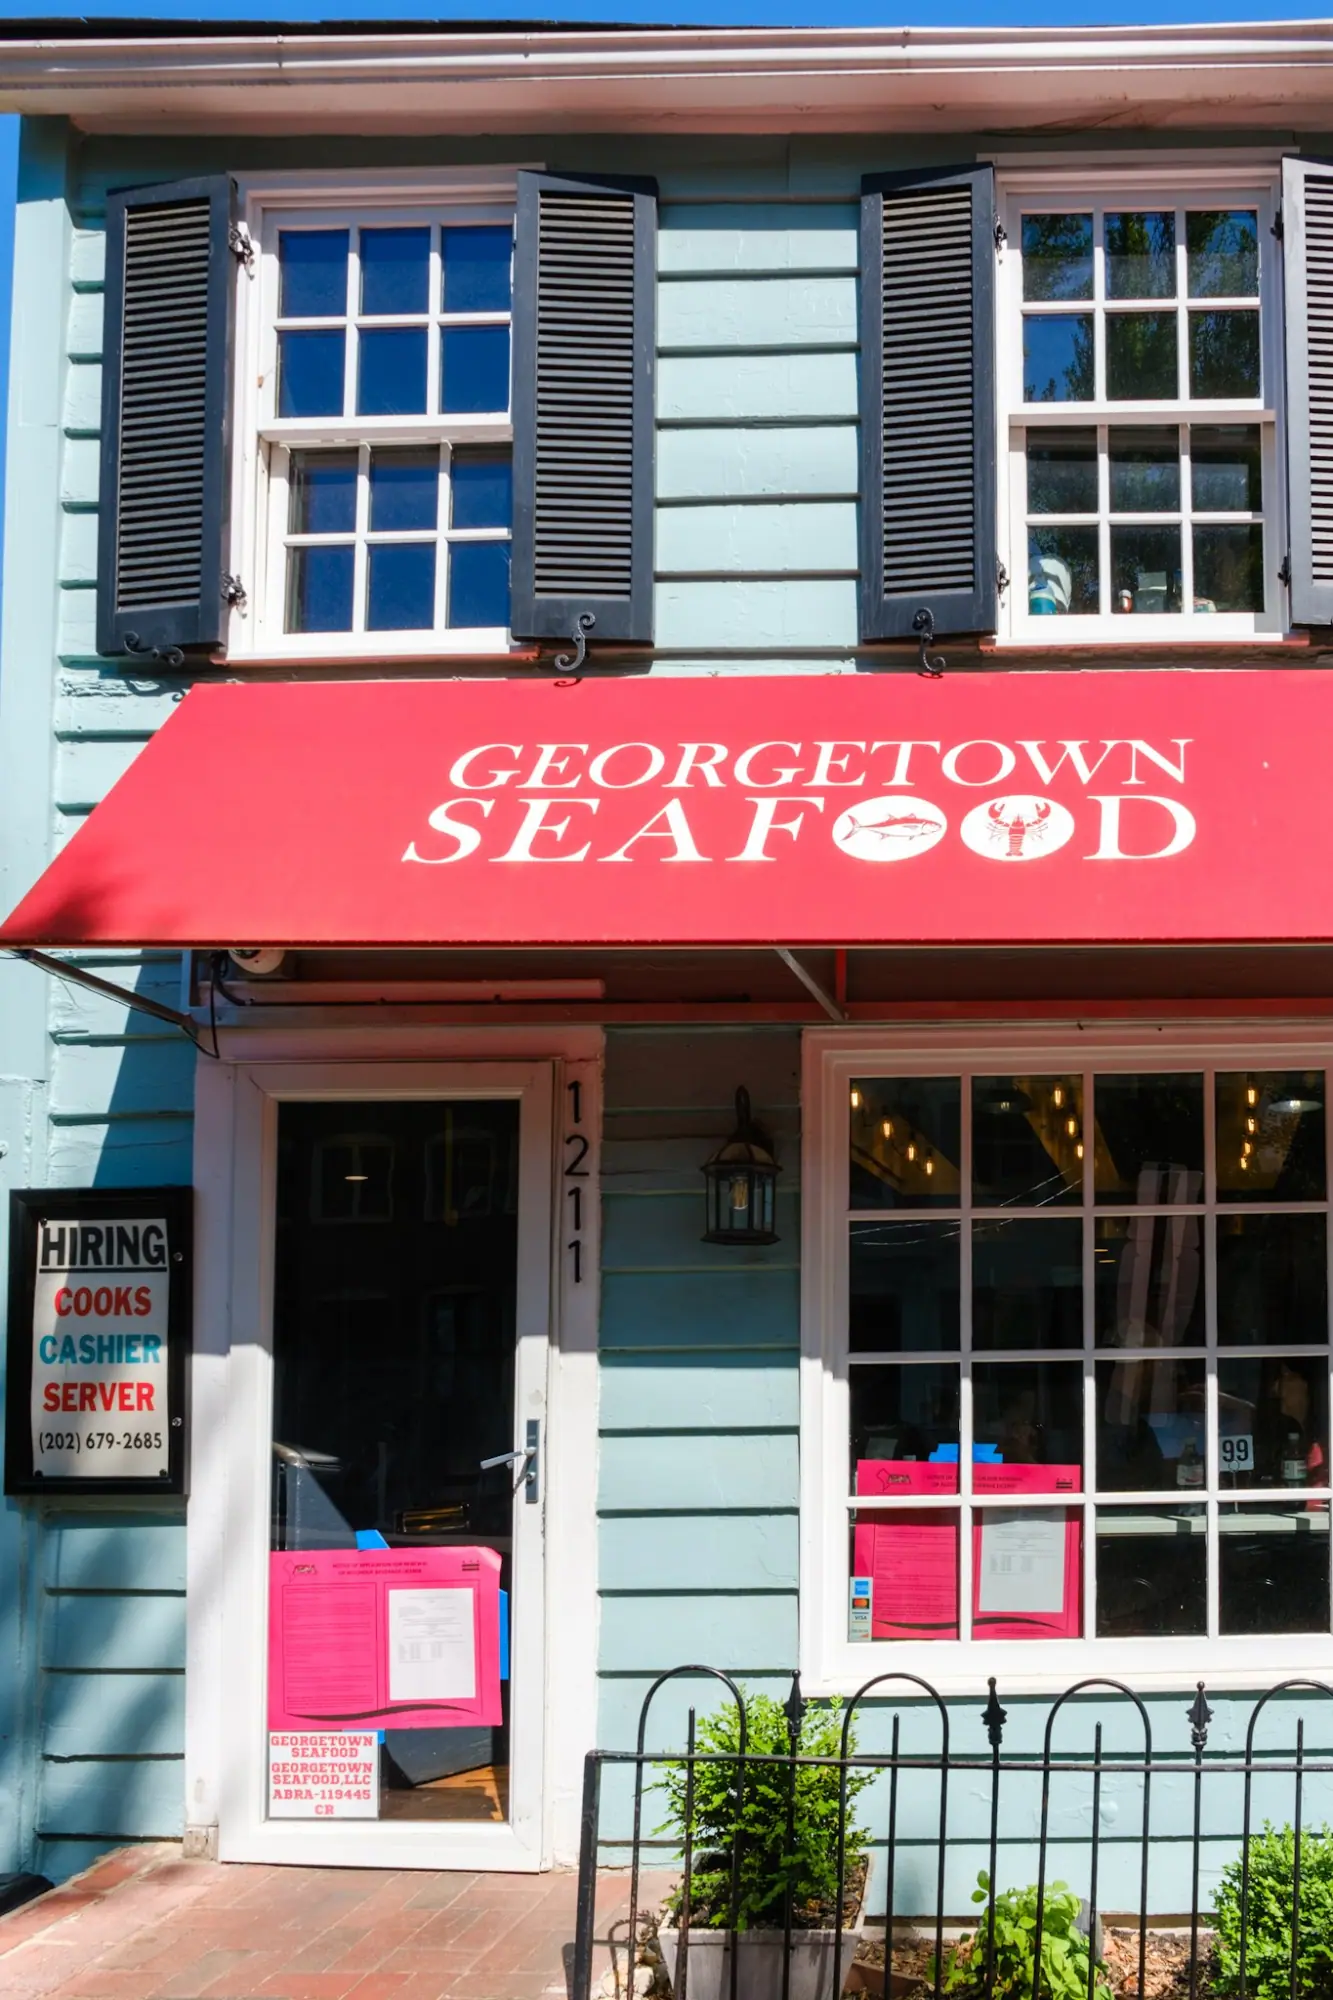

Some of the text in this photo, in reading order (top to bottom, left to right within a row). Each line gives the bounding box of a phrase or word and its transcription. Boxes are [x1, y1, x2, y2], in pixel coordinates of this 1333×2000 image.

[448, 738, 1195, 792] GEORGETOWN
[564, 1080, 590, 1284] 1211
[40, 1225, 166, 1267] HIRING
[54, 1286, 152, 1317] COOKS
[39, 1334, 162, 1364] CASHIER
[42, 1382, 155, 1412] SERVER
[38, 1432, 163, 1454] (202) 679-2685
[1222, 1439, 1249, 1463] 99
[270, 1736, 373, 1747] GEORGETOWN
[291, 1747, 358, 1758] SEAFOOD
[271, 1763, 373, 1774] GEORGETOWN
[272, 1789, 371, 1800] ABRA-119445
[314, 1804, 334, 1815] CR
